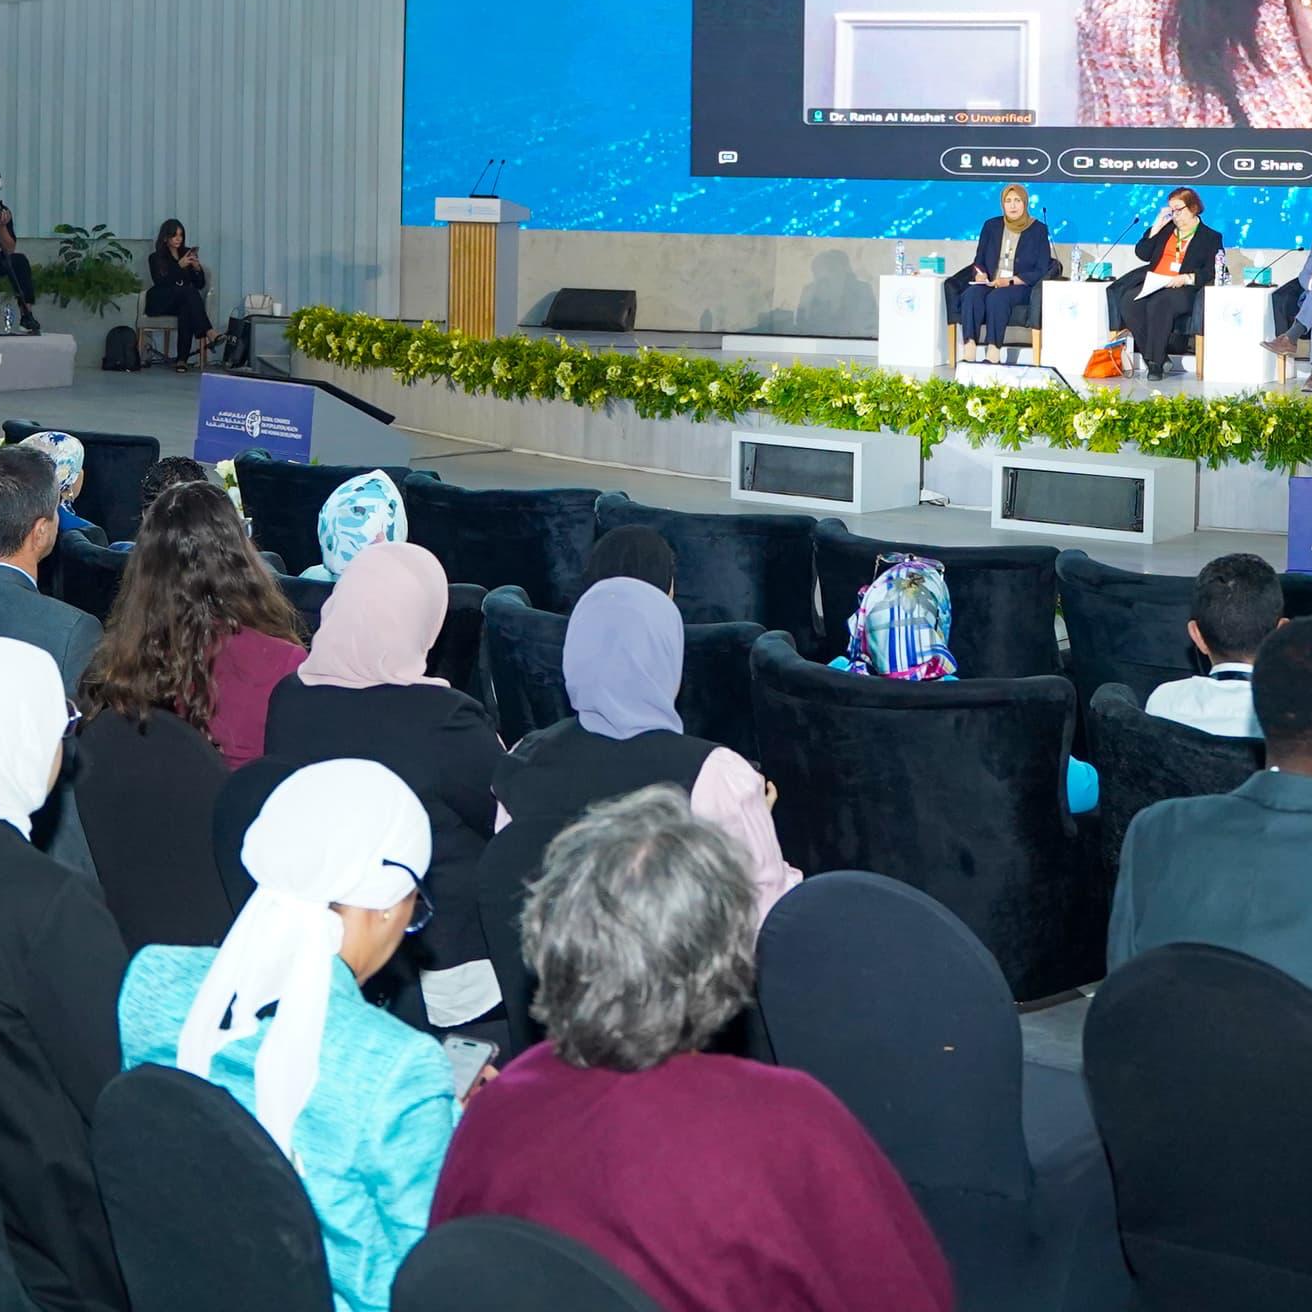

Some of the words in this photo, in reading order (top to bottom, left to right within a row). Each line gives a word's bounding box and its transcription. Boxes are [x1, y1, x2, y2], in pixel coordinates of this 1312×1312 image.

[829, 112, 847, 123] Dr.
[849, 112, 883, 123] Rania
[901, 112, 946, 123] Mashat
[970, 113, 1032, 124] Unverified
[981, 155, 1020, 168] Mute
[1099, 157, 1134, 172] Stop
[1137, 158, 1179, 170] video
[1260, 159, 1303, 171] Share
